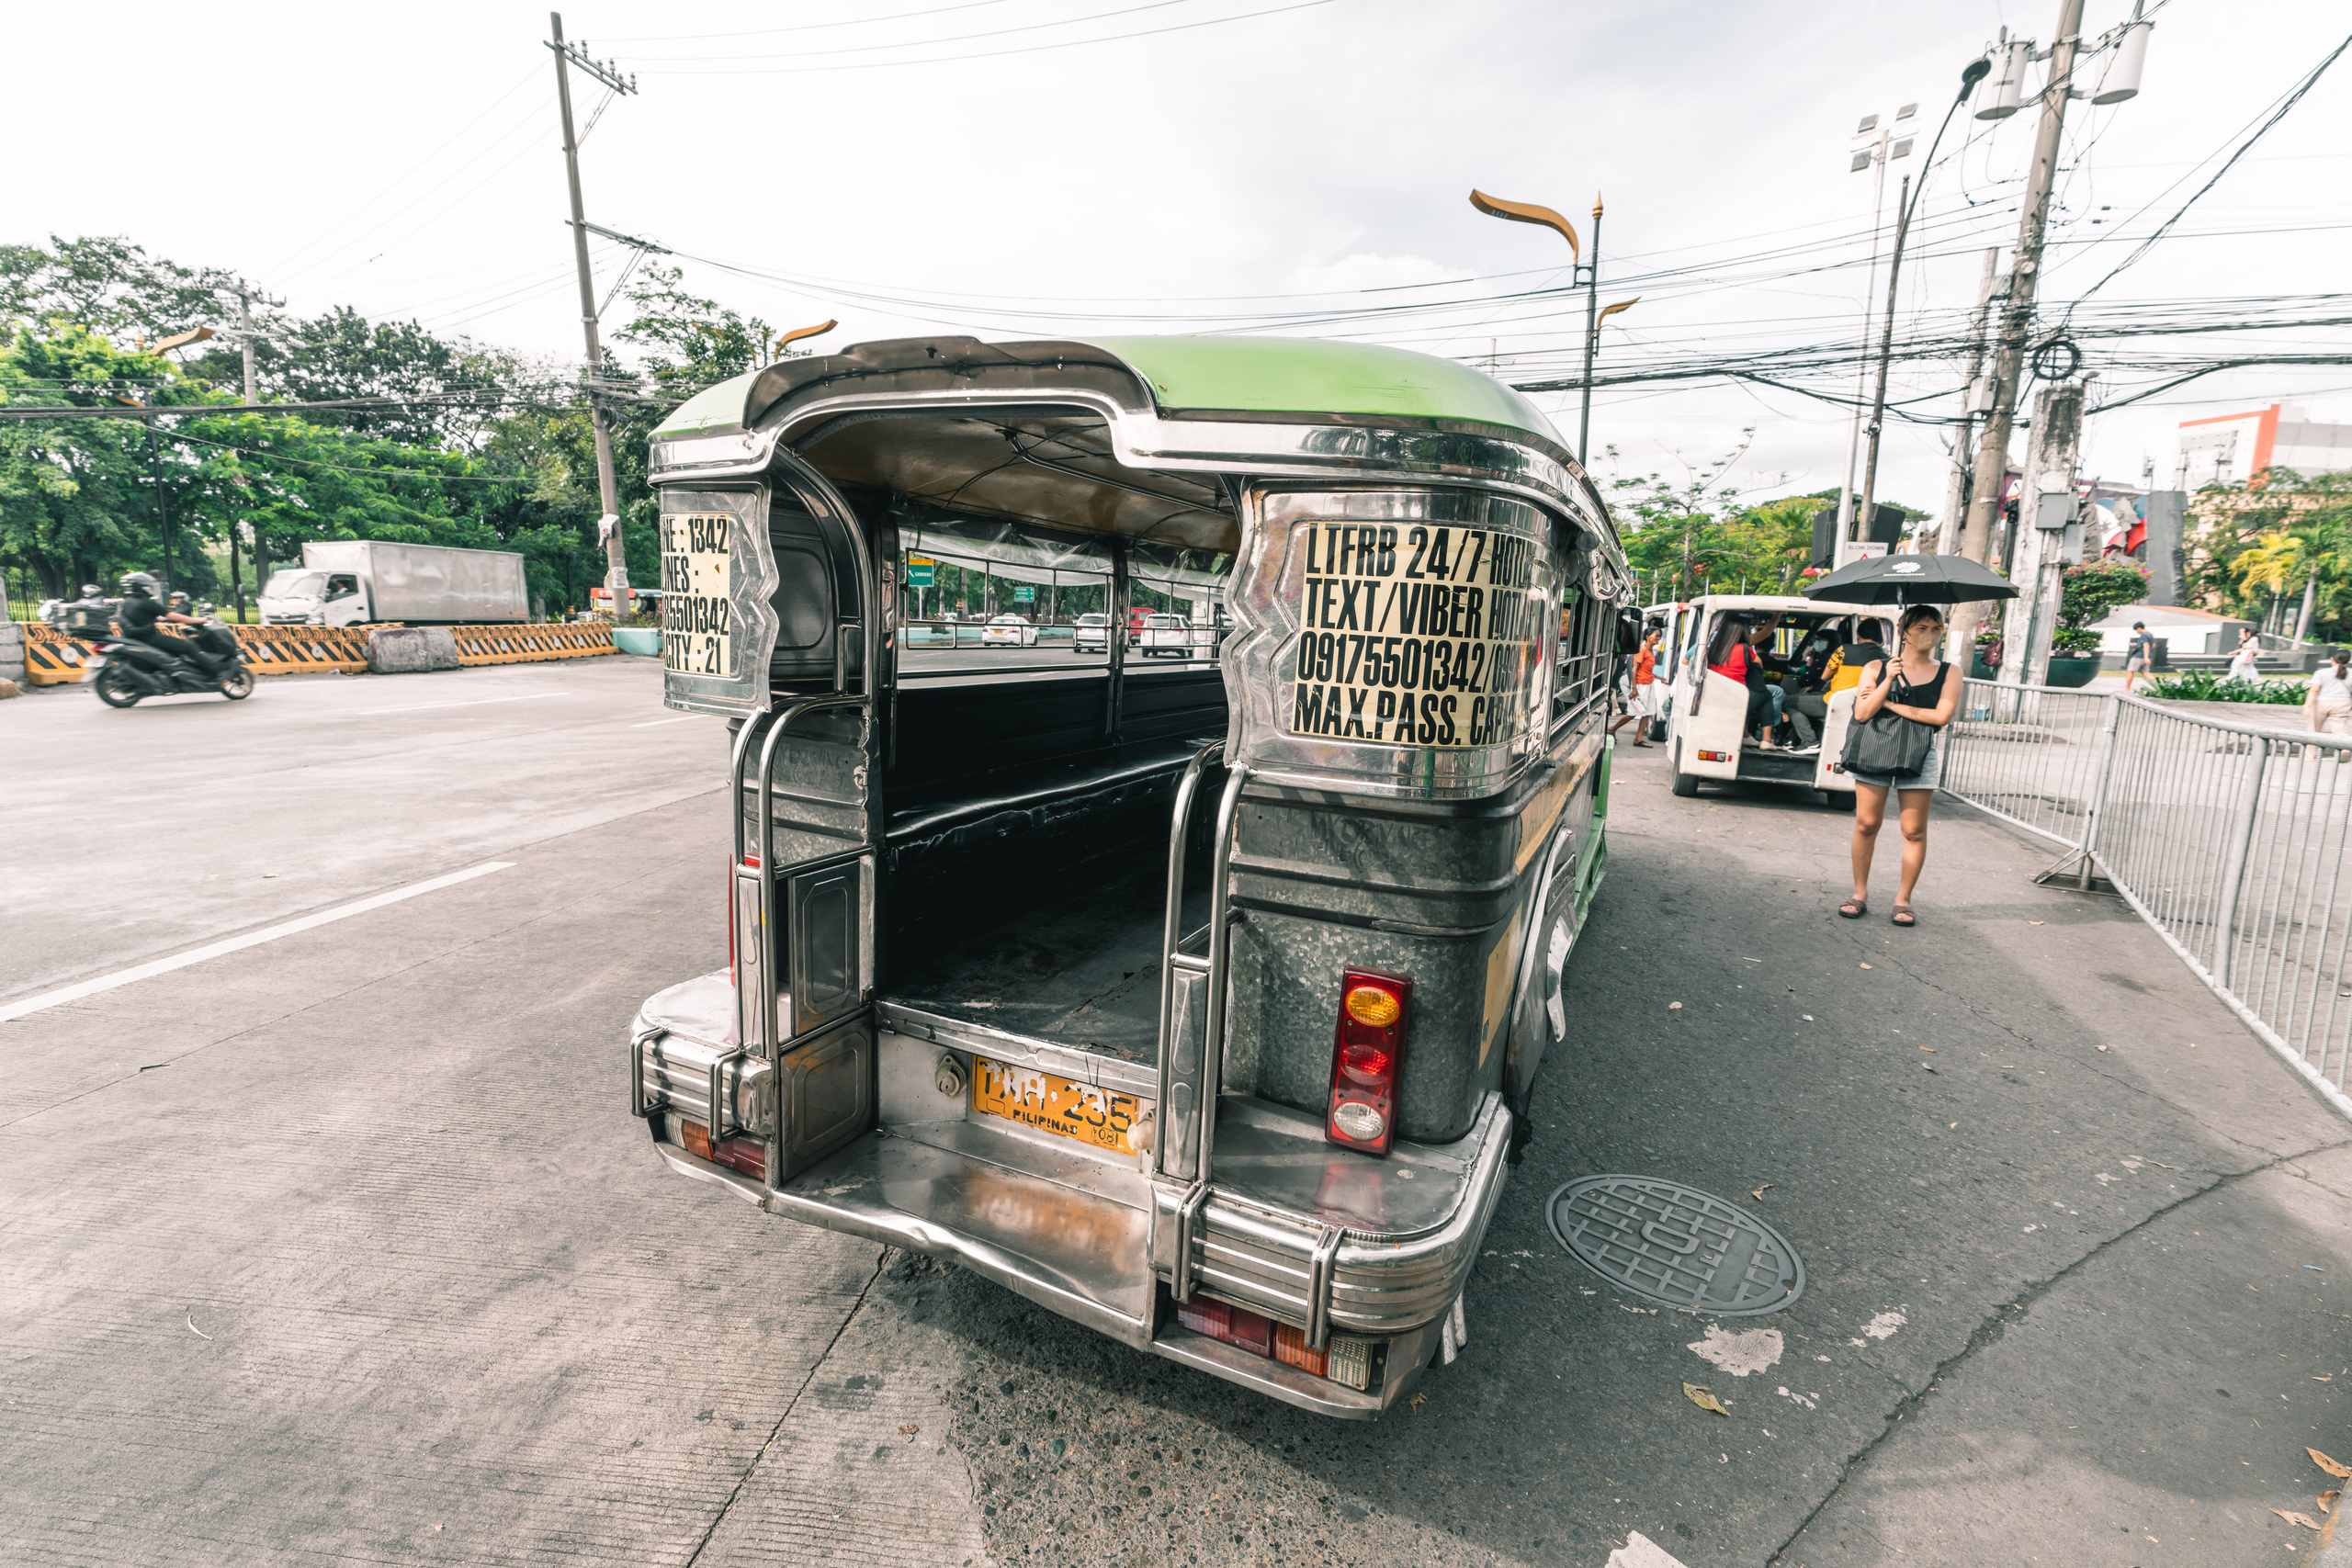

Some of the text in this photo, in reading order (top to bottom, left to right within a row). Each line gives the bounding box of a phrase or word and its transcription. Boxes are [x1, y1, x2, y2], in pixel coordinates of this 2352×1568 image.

[688, 515, 729, 554] 1342
[1306, 522, 1399, 577] LTFRB
[1406, 526, 1487, 585] 24/7
[1305, 577, 1484, 639] TEXT/VIBER
[706, 636, 721, 675] 21
[1012, 1109, 1078, 1134] PILIPINAS
